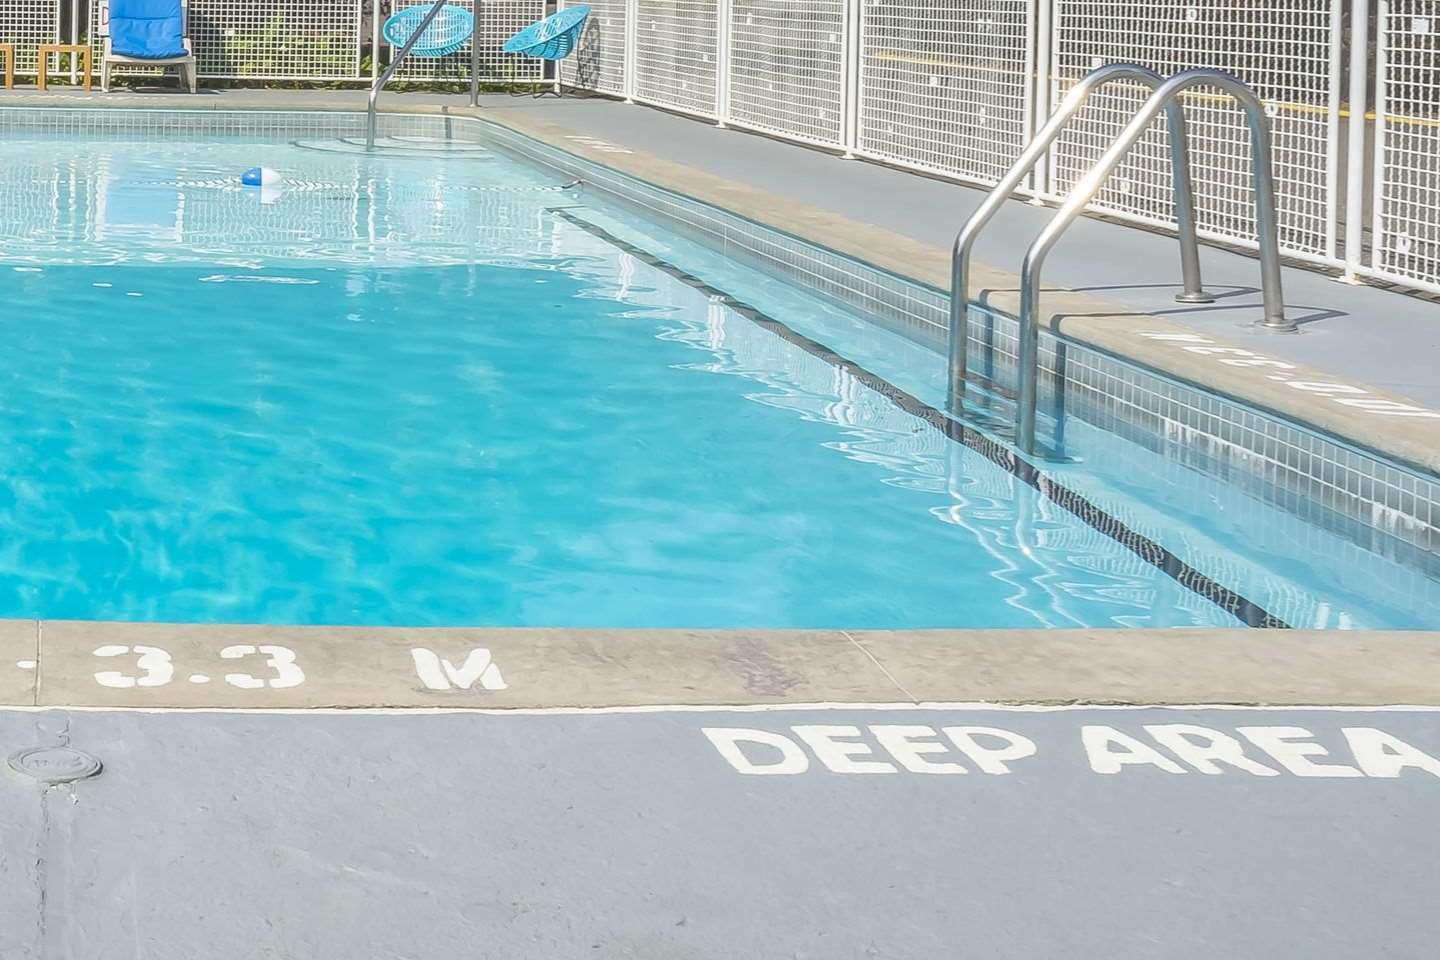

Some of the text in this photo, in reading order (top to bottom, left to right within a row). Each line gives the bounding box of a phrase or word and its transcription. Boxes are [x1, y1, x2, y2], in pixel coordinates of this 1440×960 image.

[93, 645, 306, 689] 3.3
[411, 647, 508, 690] M
[700, 723, 1440, 778] DEEP AREA
